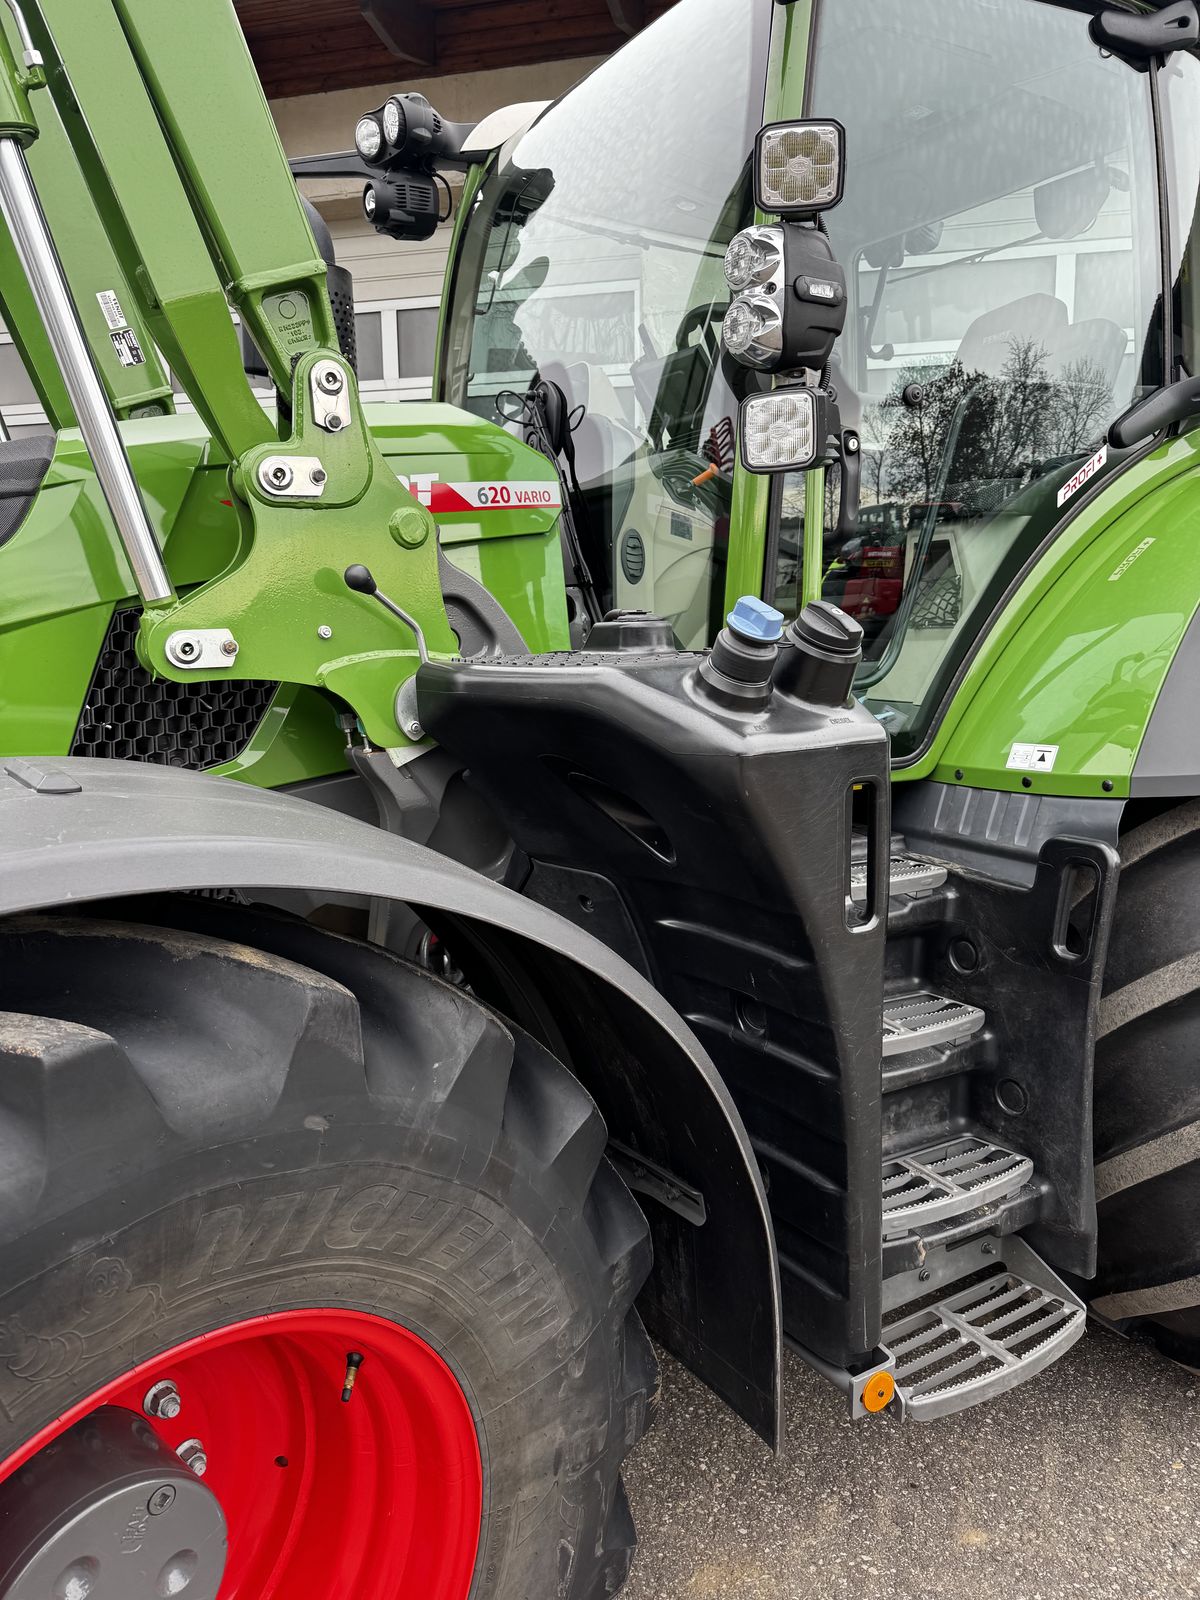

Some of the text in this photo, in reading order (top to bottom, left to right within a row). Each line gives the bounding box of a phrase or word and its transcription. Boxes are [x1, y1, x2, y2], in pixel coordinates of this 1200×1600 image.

[477, 486, 551, 504] 620 VARIO
[176, 1182, 570, 1345] MICHELIN
